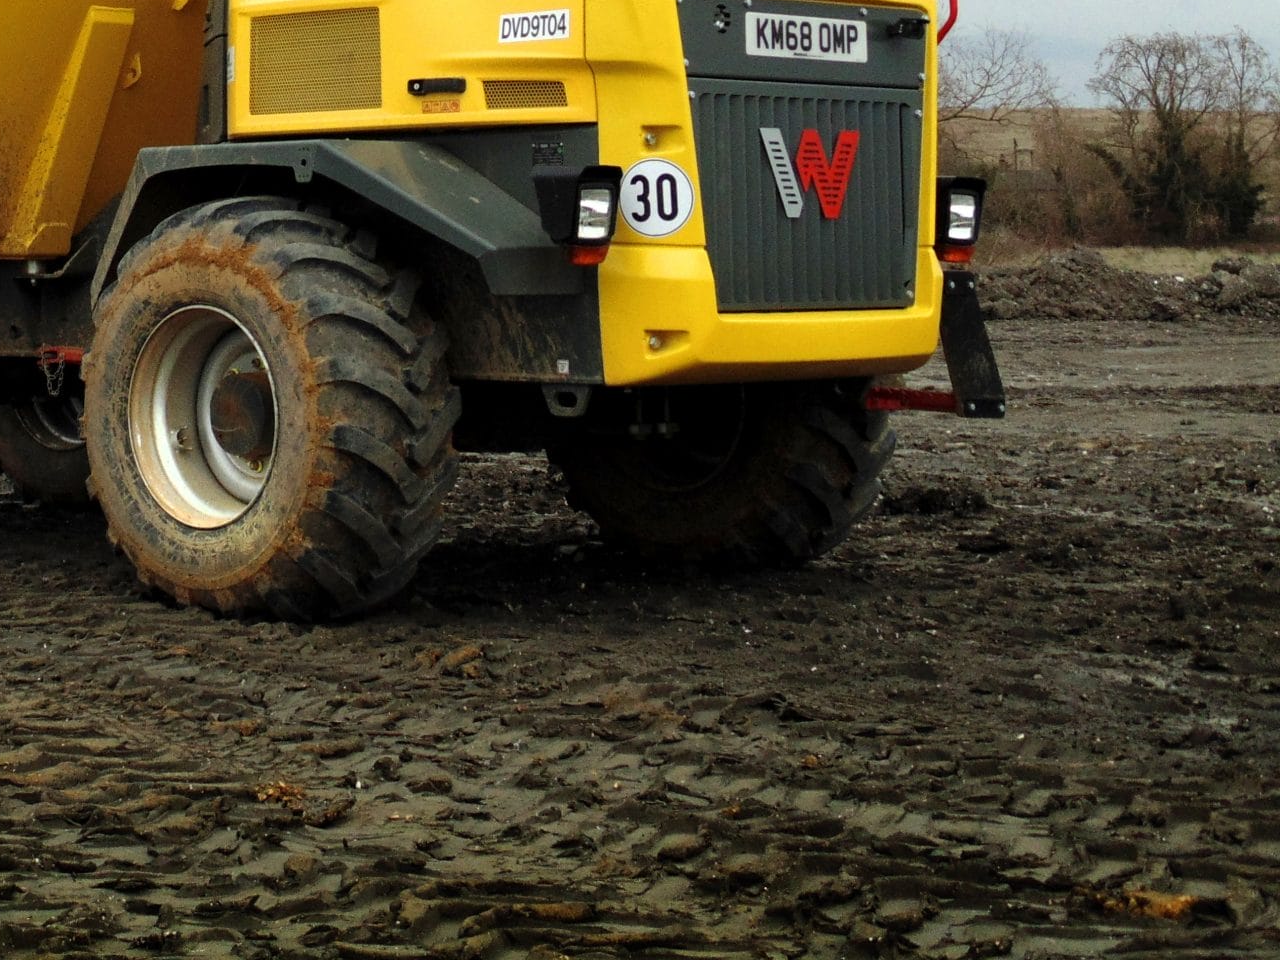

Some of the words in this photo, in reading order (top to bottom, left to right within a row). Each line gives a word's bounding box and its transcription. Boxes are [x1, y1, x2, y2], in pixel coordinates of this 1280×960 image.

[501, 12, 567, 40] DVD9T04
[756, 17, 813, 52] KM68
[819, 22, 858, 54] OMP
[629, 172, 679, 223] 30
